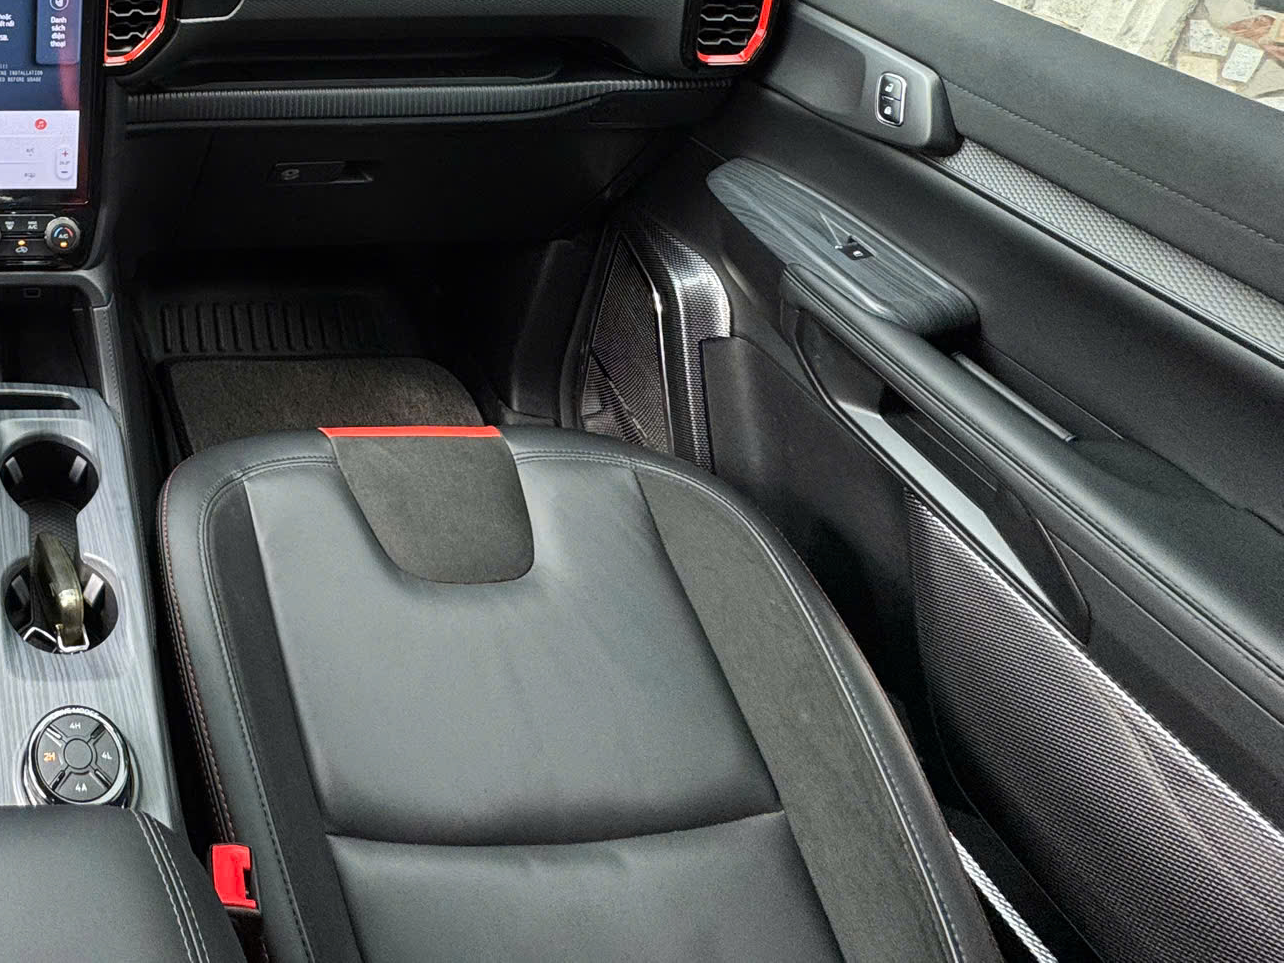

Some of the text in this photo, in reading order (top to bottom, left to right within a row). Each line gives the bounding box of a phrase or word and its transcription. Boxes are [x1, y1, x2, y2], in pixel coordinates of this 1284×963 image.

[44, 752, 55, 761] 2H
[101, 751, 112, 759] 4L
[75, 783, 87, 792] 4A
